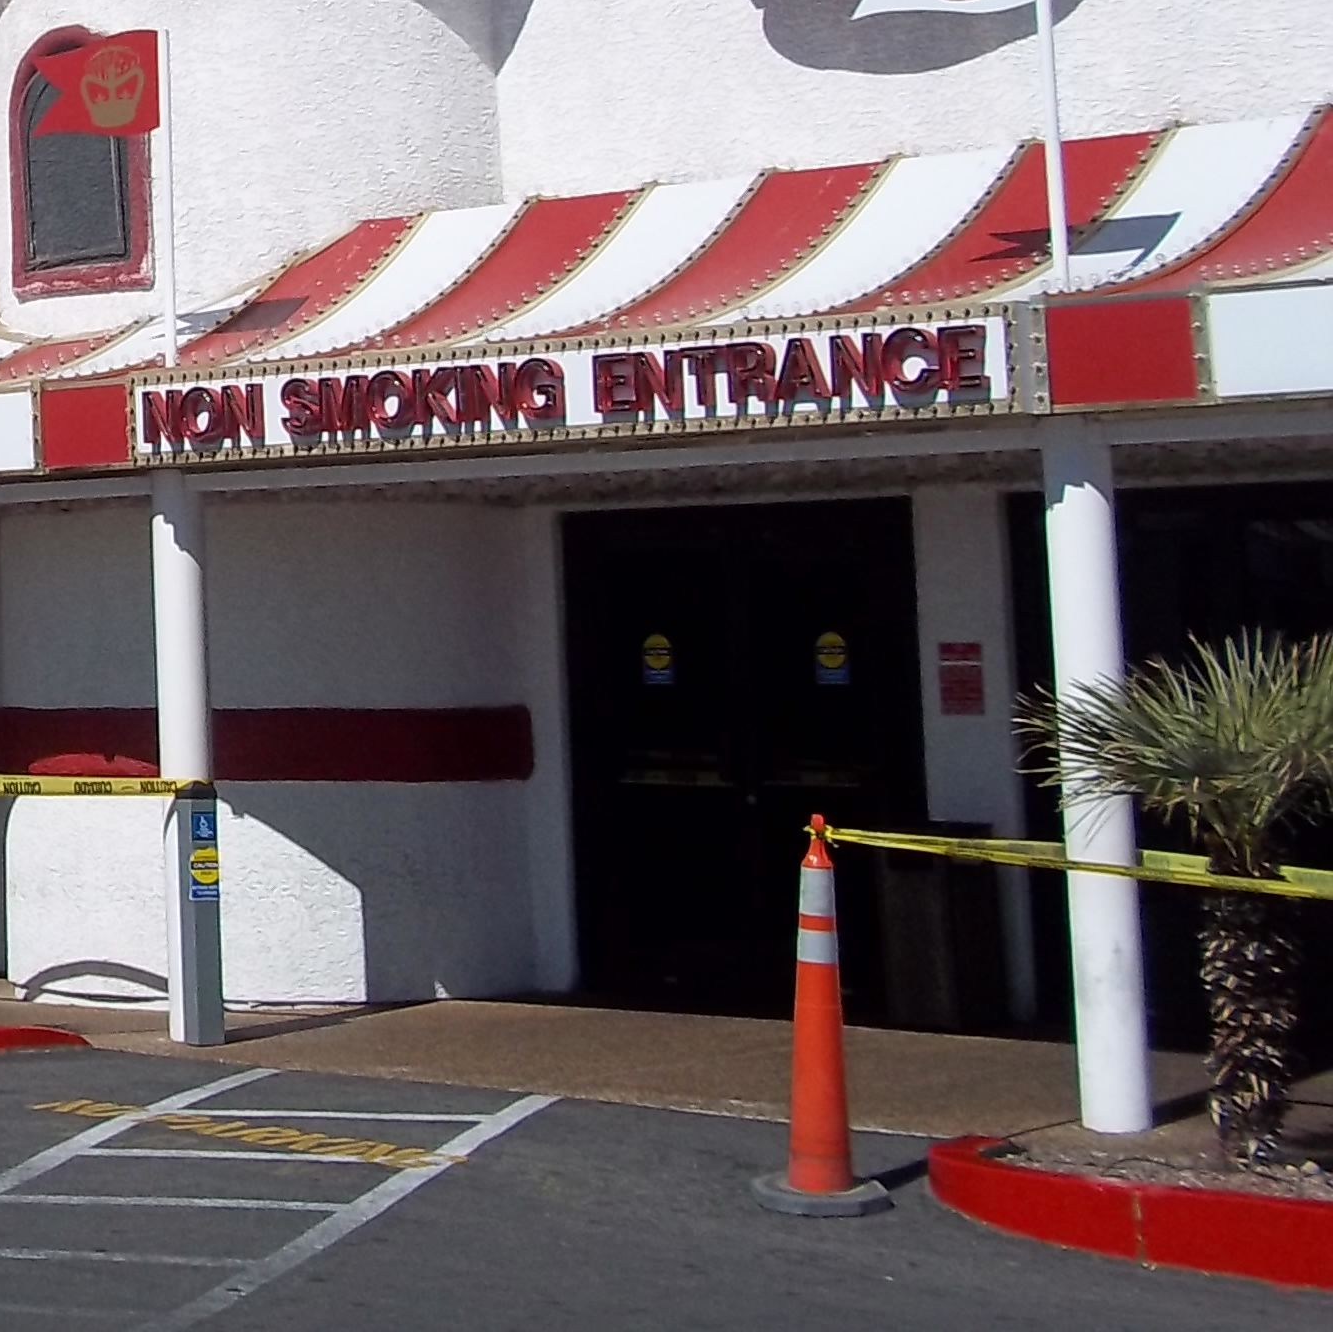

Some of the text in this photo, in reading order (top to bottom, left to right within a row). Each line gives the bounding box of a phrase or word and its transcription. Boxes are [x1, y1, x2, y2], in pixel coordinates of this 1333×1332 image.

[142, 324, 988, 445] NON SMOKING ENTRANCE
